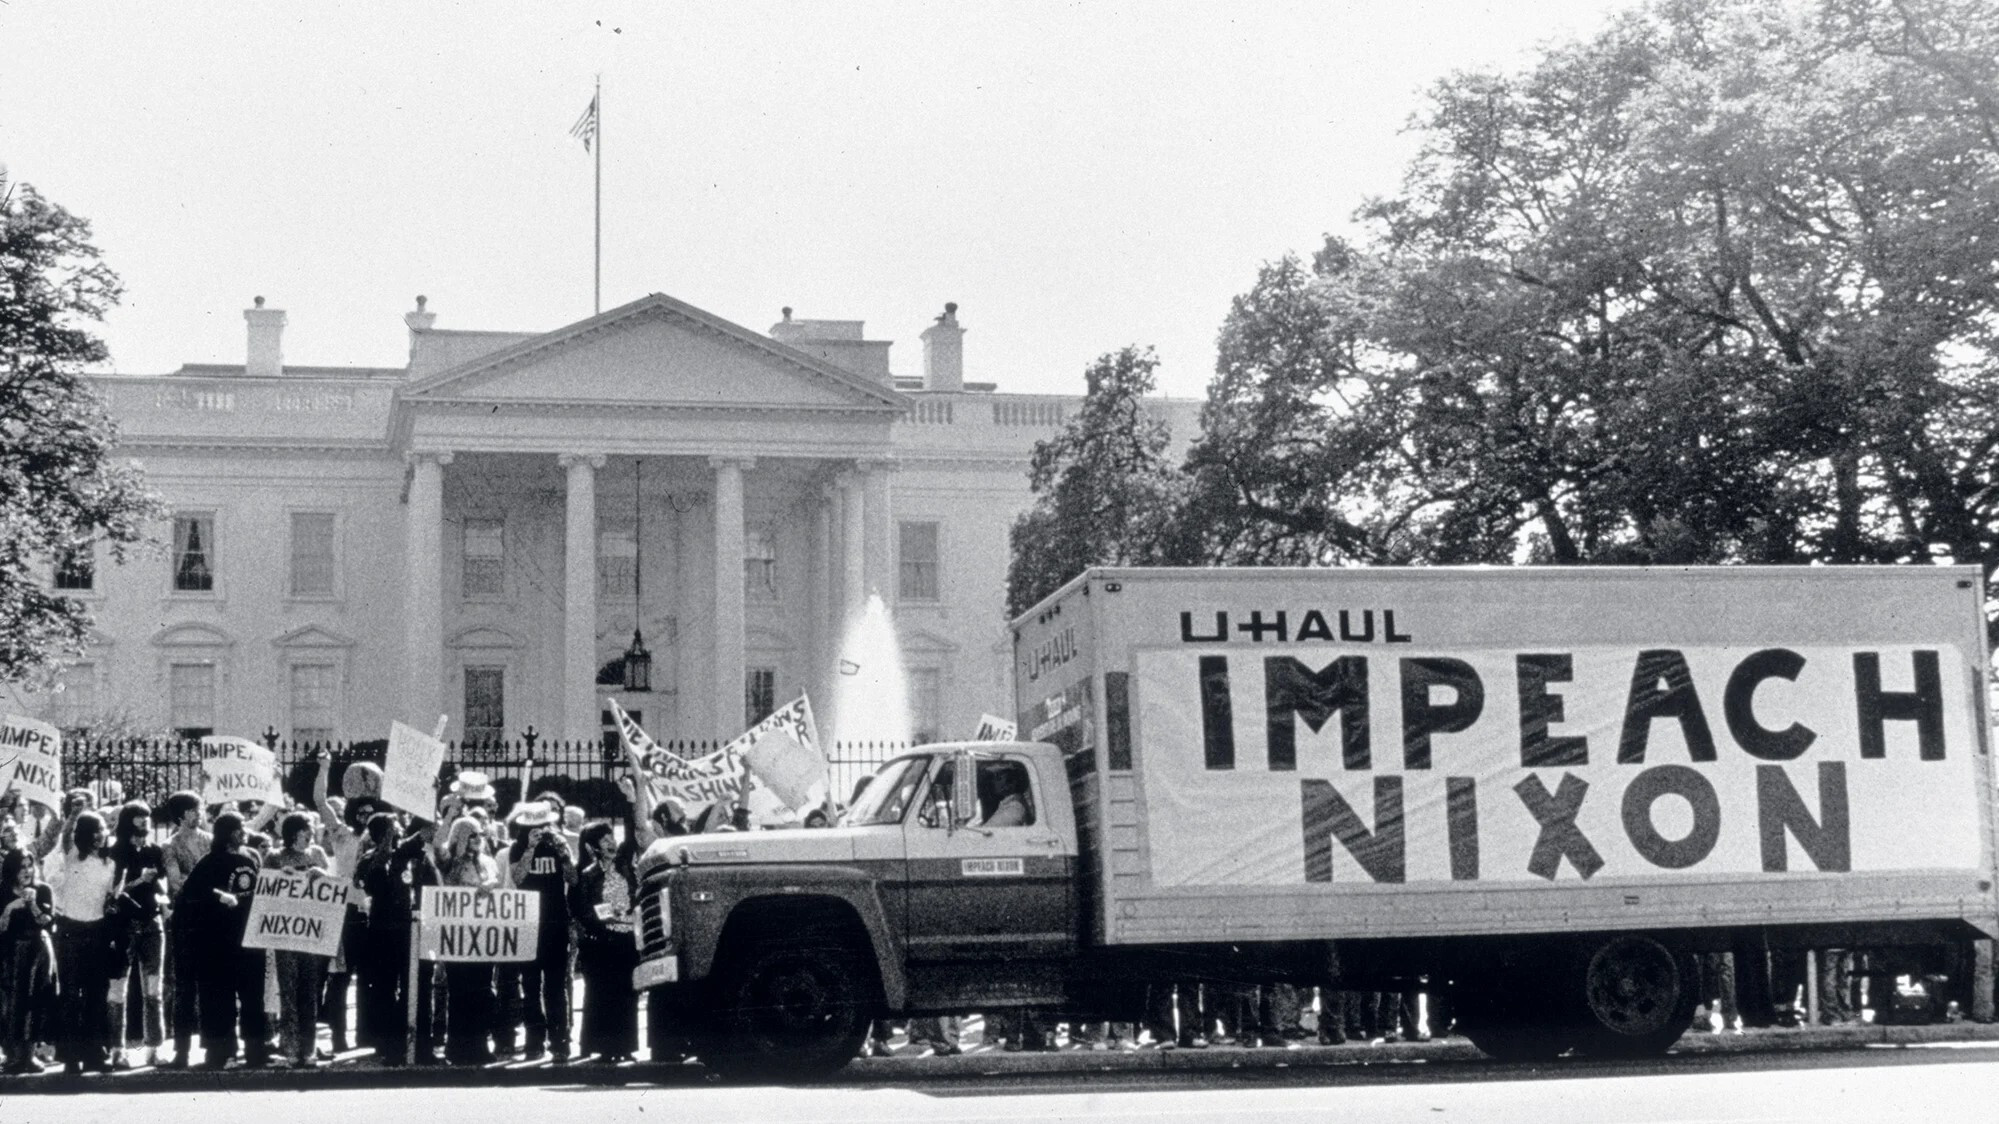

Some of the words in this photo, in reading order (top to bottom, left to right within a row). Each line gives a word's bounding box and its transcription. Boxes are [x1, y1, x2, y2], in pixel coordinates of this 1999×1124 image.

[1180, 609, 1412, 643] U-HAUL
[1028, 627, 1077, 681] U-HAUL
[1199, 648, 1946, 771] IMPEACH
[1301, 760, 1852, 884] NIXON
[256, 876, 348, 905] IMPEACH
[434, 891, 526, 920] IMPEACH
[260, 914, 322, 939] NIXON
[440, 924, 518, 957] NIXON
